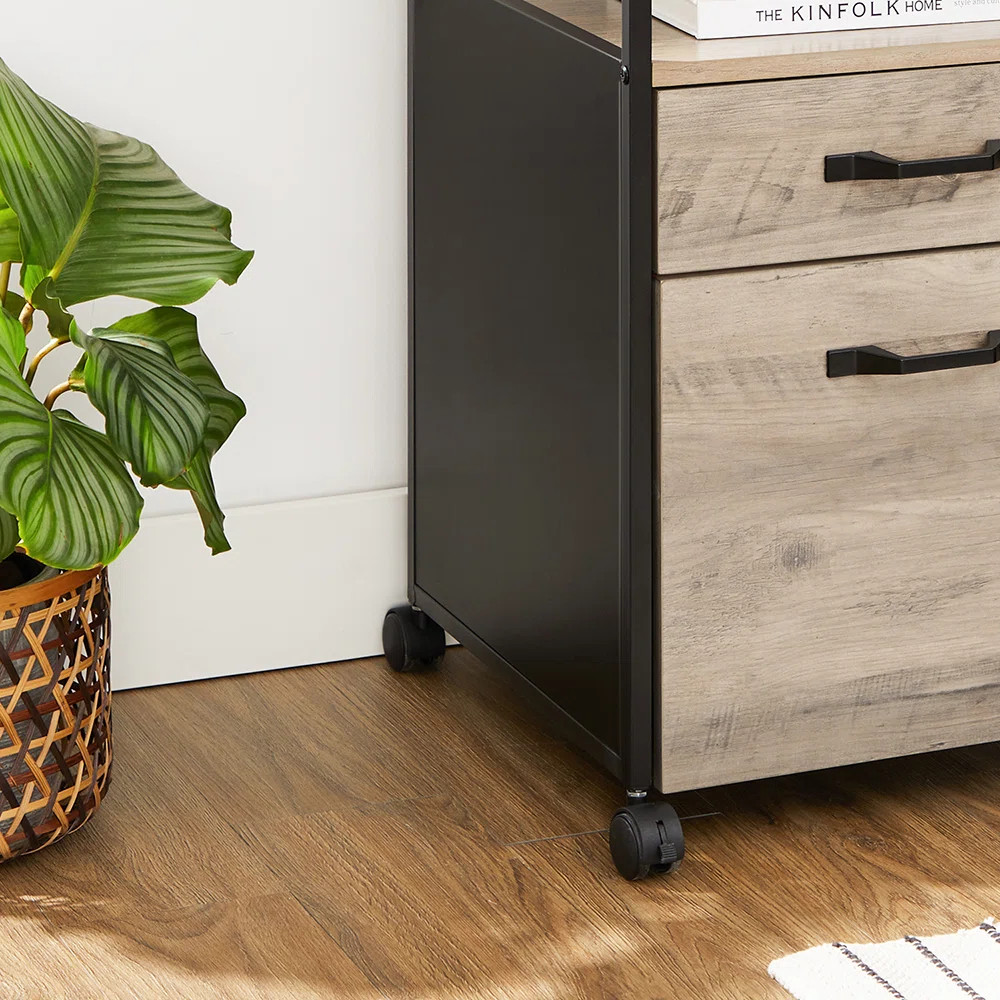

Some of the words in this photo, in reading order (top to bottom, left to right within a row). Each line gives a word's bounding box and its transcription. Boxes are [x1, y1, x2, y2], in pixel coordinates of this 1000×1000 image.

[756, 9, 783, 22] THE
[791, 0, 900, 22] KINFOLK
[905, 0, 943, 13] HOME
